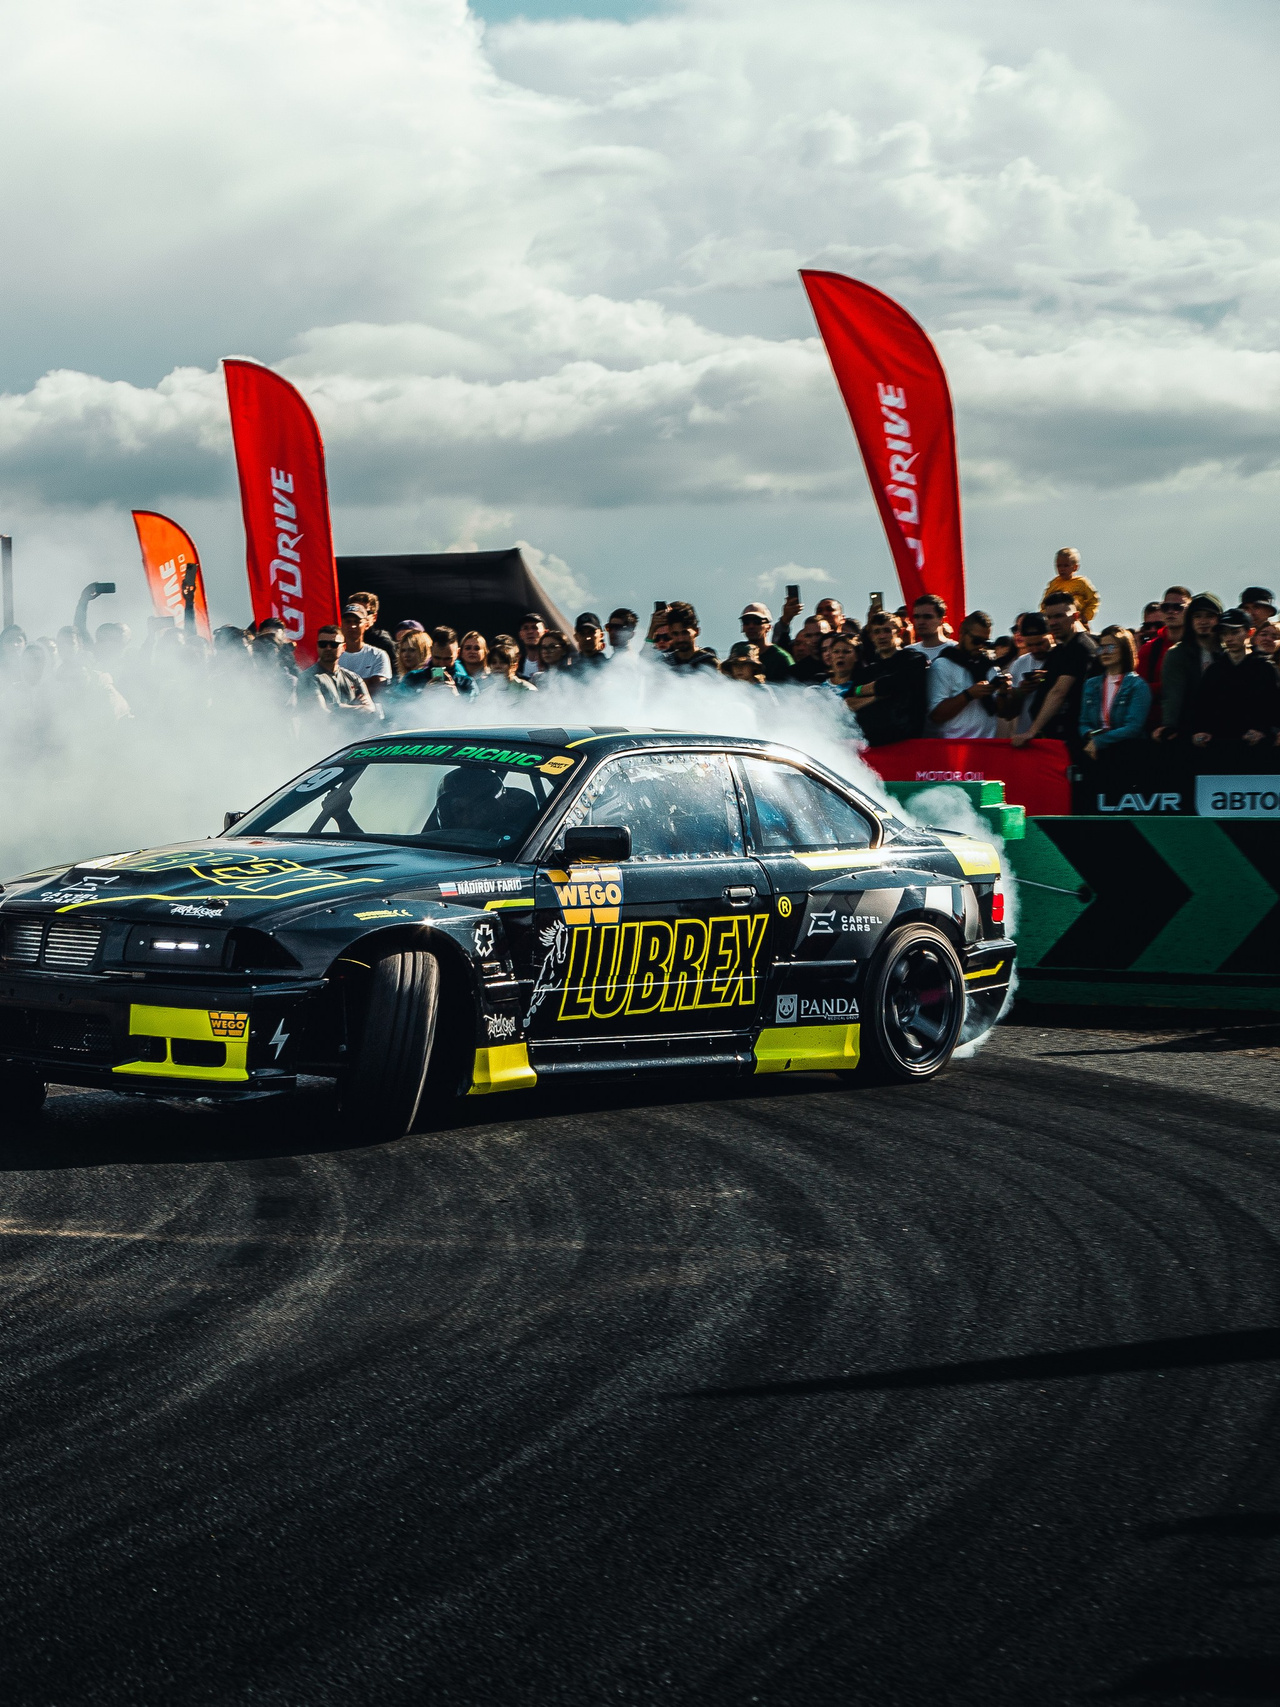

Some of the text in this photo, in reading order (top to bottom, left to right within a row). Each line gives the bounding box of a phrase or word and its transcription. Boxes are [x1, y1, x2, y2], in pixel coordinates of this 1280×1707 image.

[345, 744, 544, 767] TSUNAMI PICNIC
[916, 771, 963, 781] MOTOR
[1097, 793, 1182, 811] LAVR
[1210, 791, 1280, 811] авто
[457, 879, 522, 894] NADIROV FARID
[554, 883, 622, 907] WEGO
[841, 915, 882, 924] CARTEL
[841, 924, 871, 932] CARS
[557, 914, 770, 1021] LUBREX
[800, 998, 860, 1015] PANDA
[211, 1019, 246, 1030] WEGO
